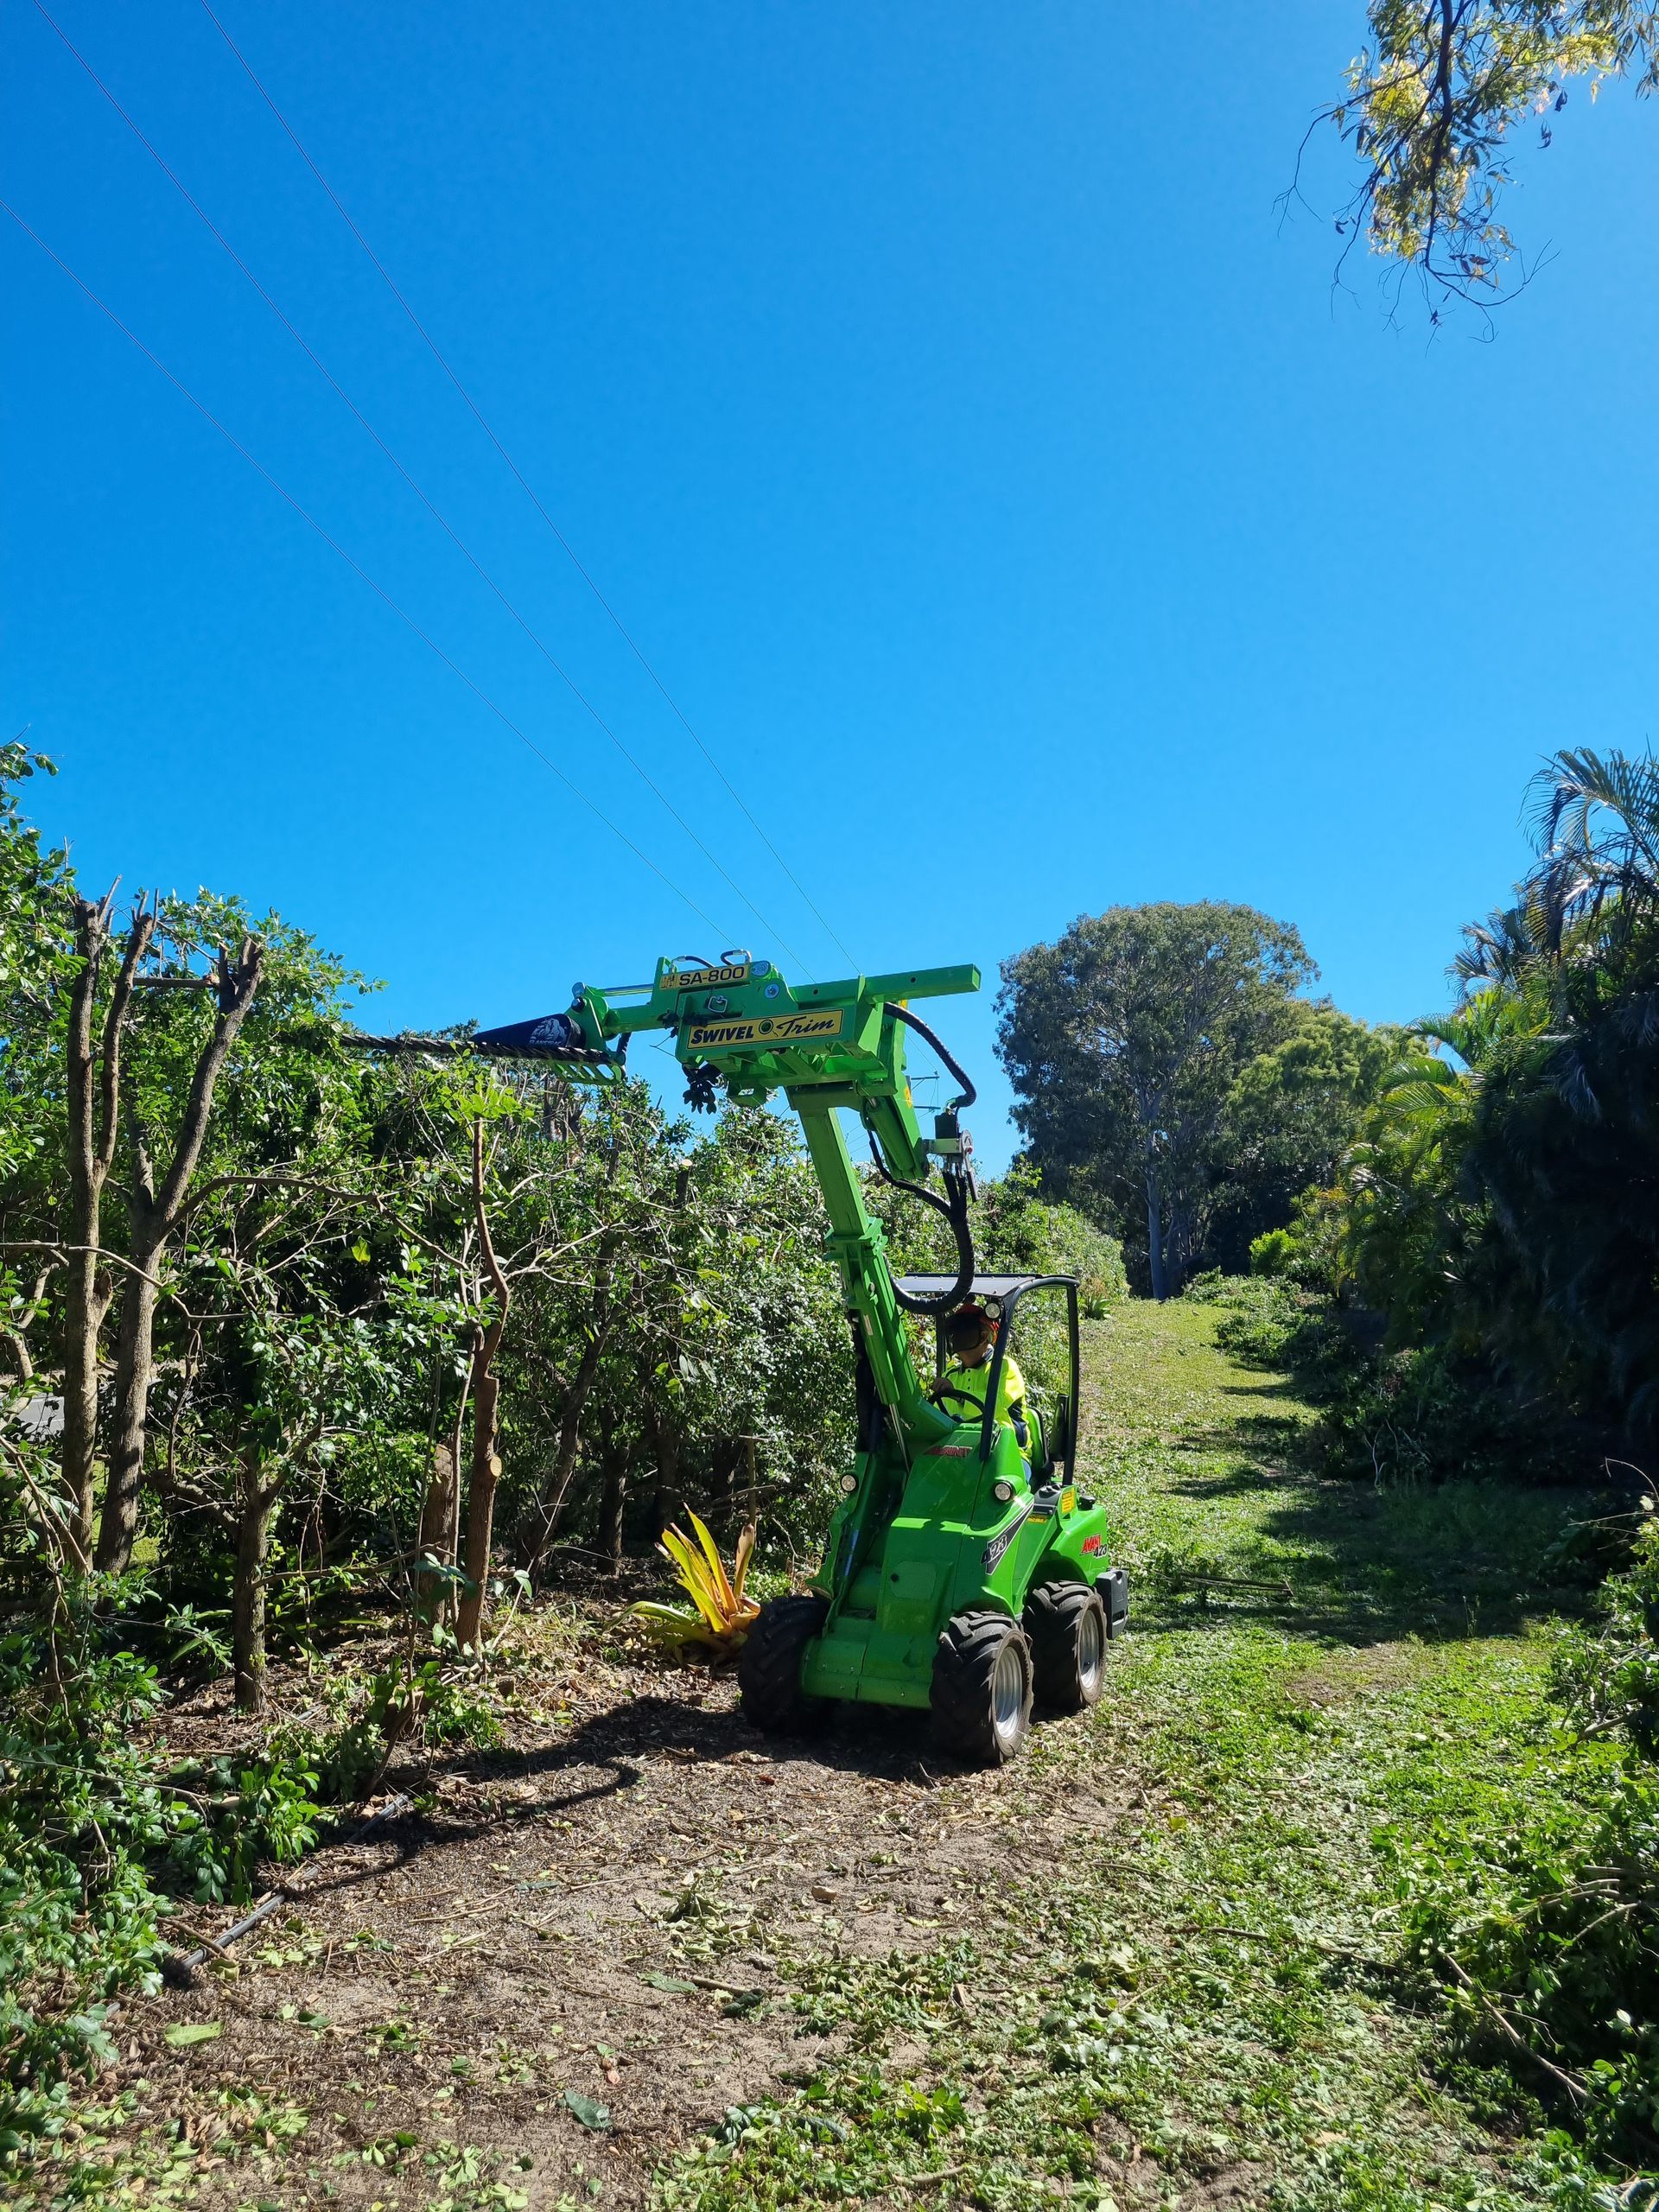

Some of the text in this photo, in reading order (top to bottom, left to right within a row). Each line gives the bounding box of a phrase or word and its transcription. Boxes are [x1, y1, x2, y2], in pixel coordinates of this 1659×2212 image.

[679, 966, 745, 986] SA-800
[691, 1015, 835, 1045] SWIVEL Trim
[980, 1534, 1007, 1564] 423
[1093, 1543, 1107, 1557] 423
